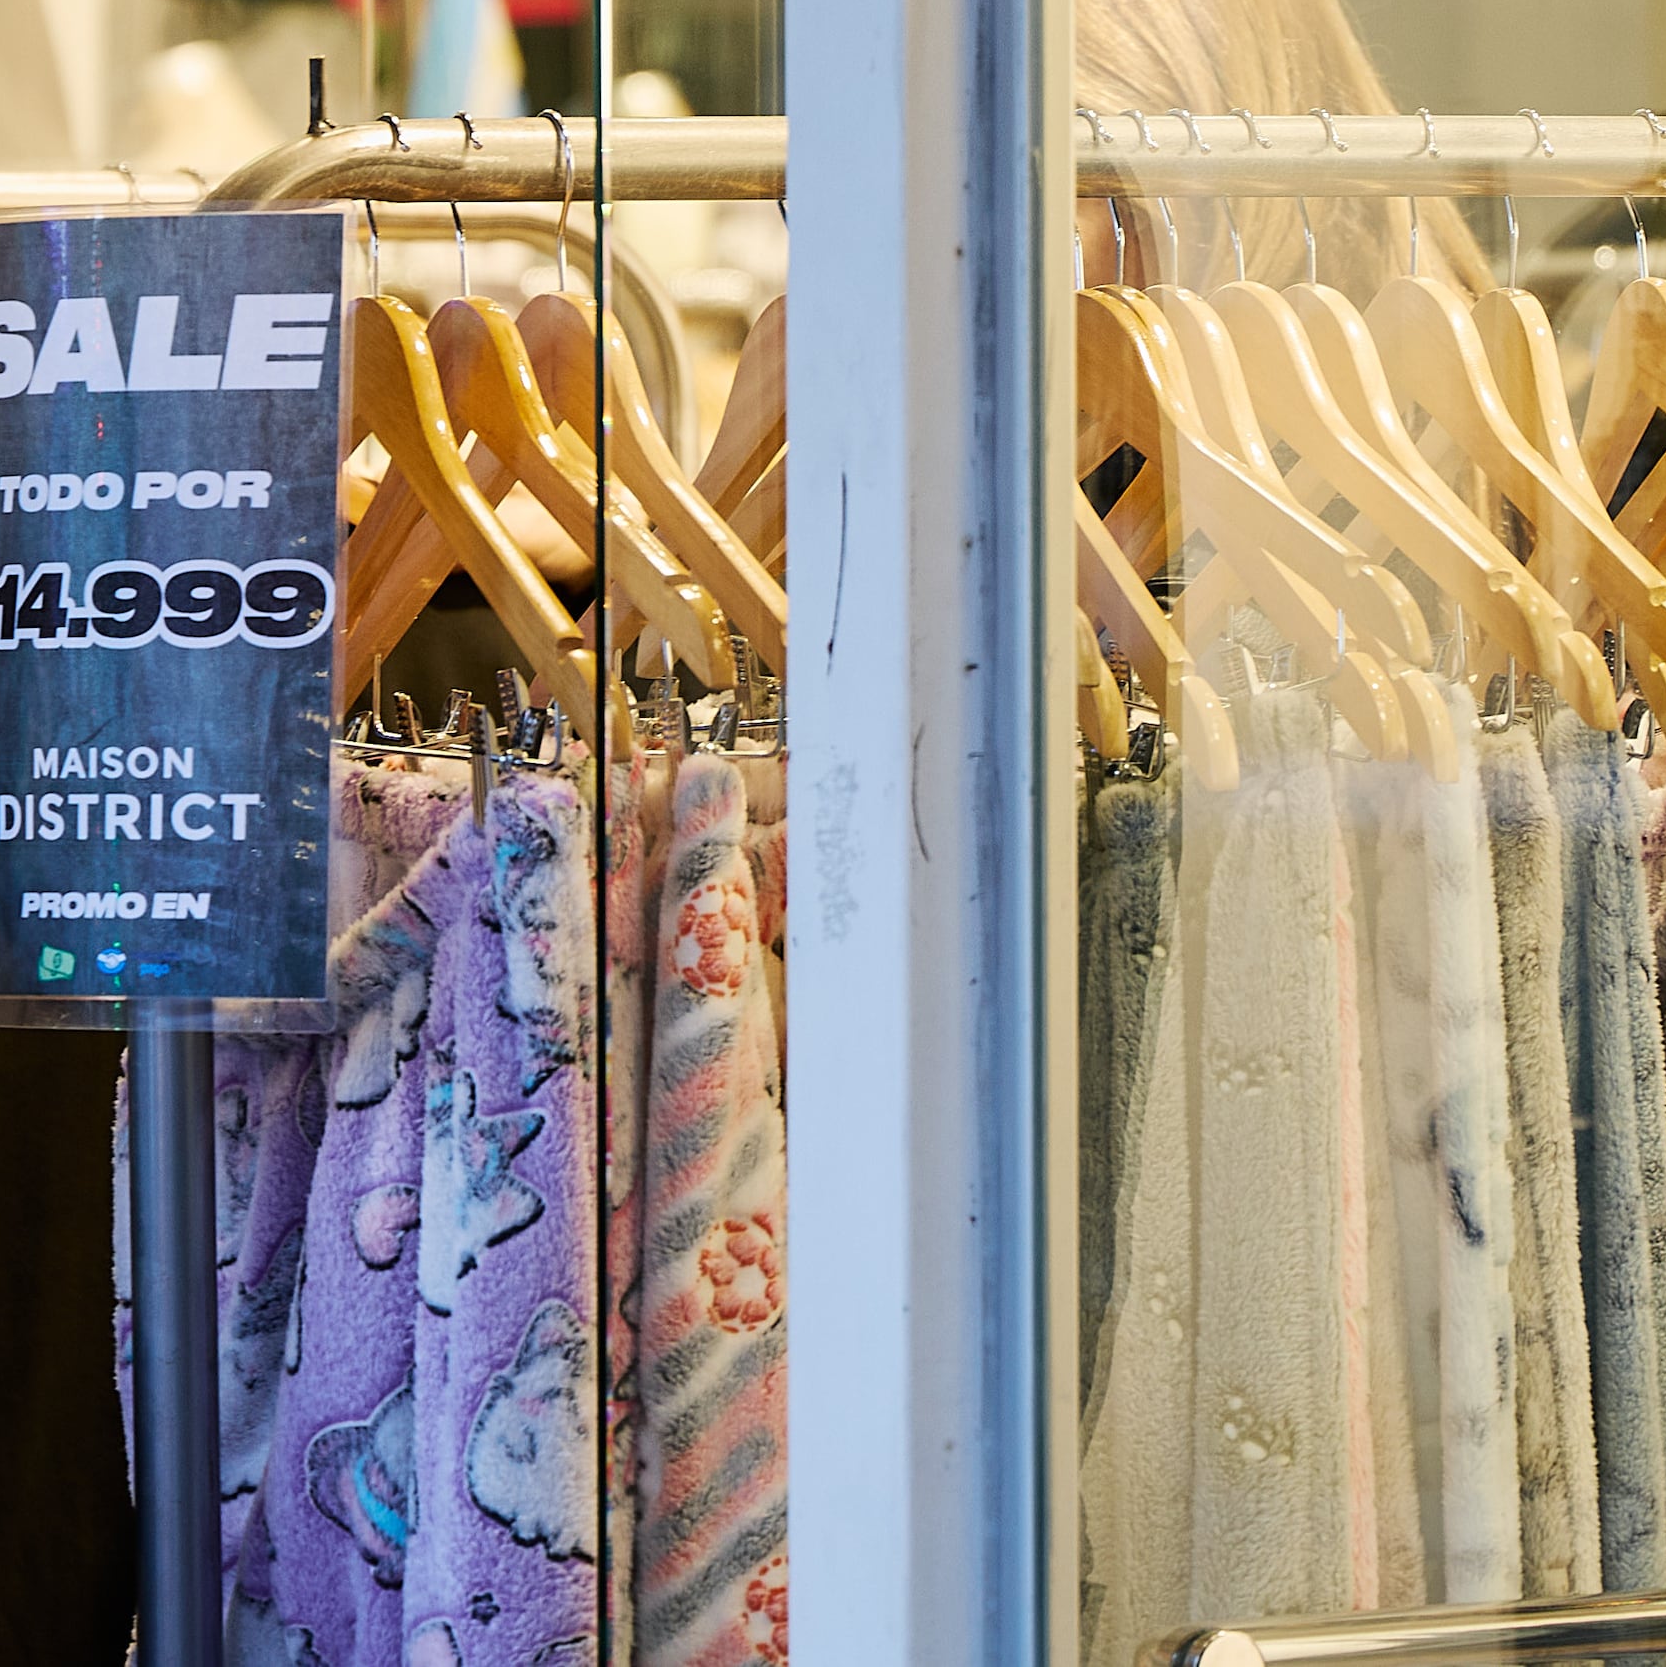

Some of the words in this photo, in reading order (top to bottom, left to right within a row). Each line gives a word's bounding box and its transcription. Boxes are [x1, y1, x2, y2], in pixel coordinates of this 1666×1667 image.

[131, 469, 273, 511] POR
[32, 746, 194, 780] MAISON
[20, 891, 148, 920] PROMO
[150, 892, 211, 920] EN
